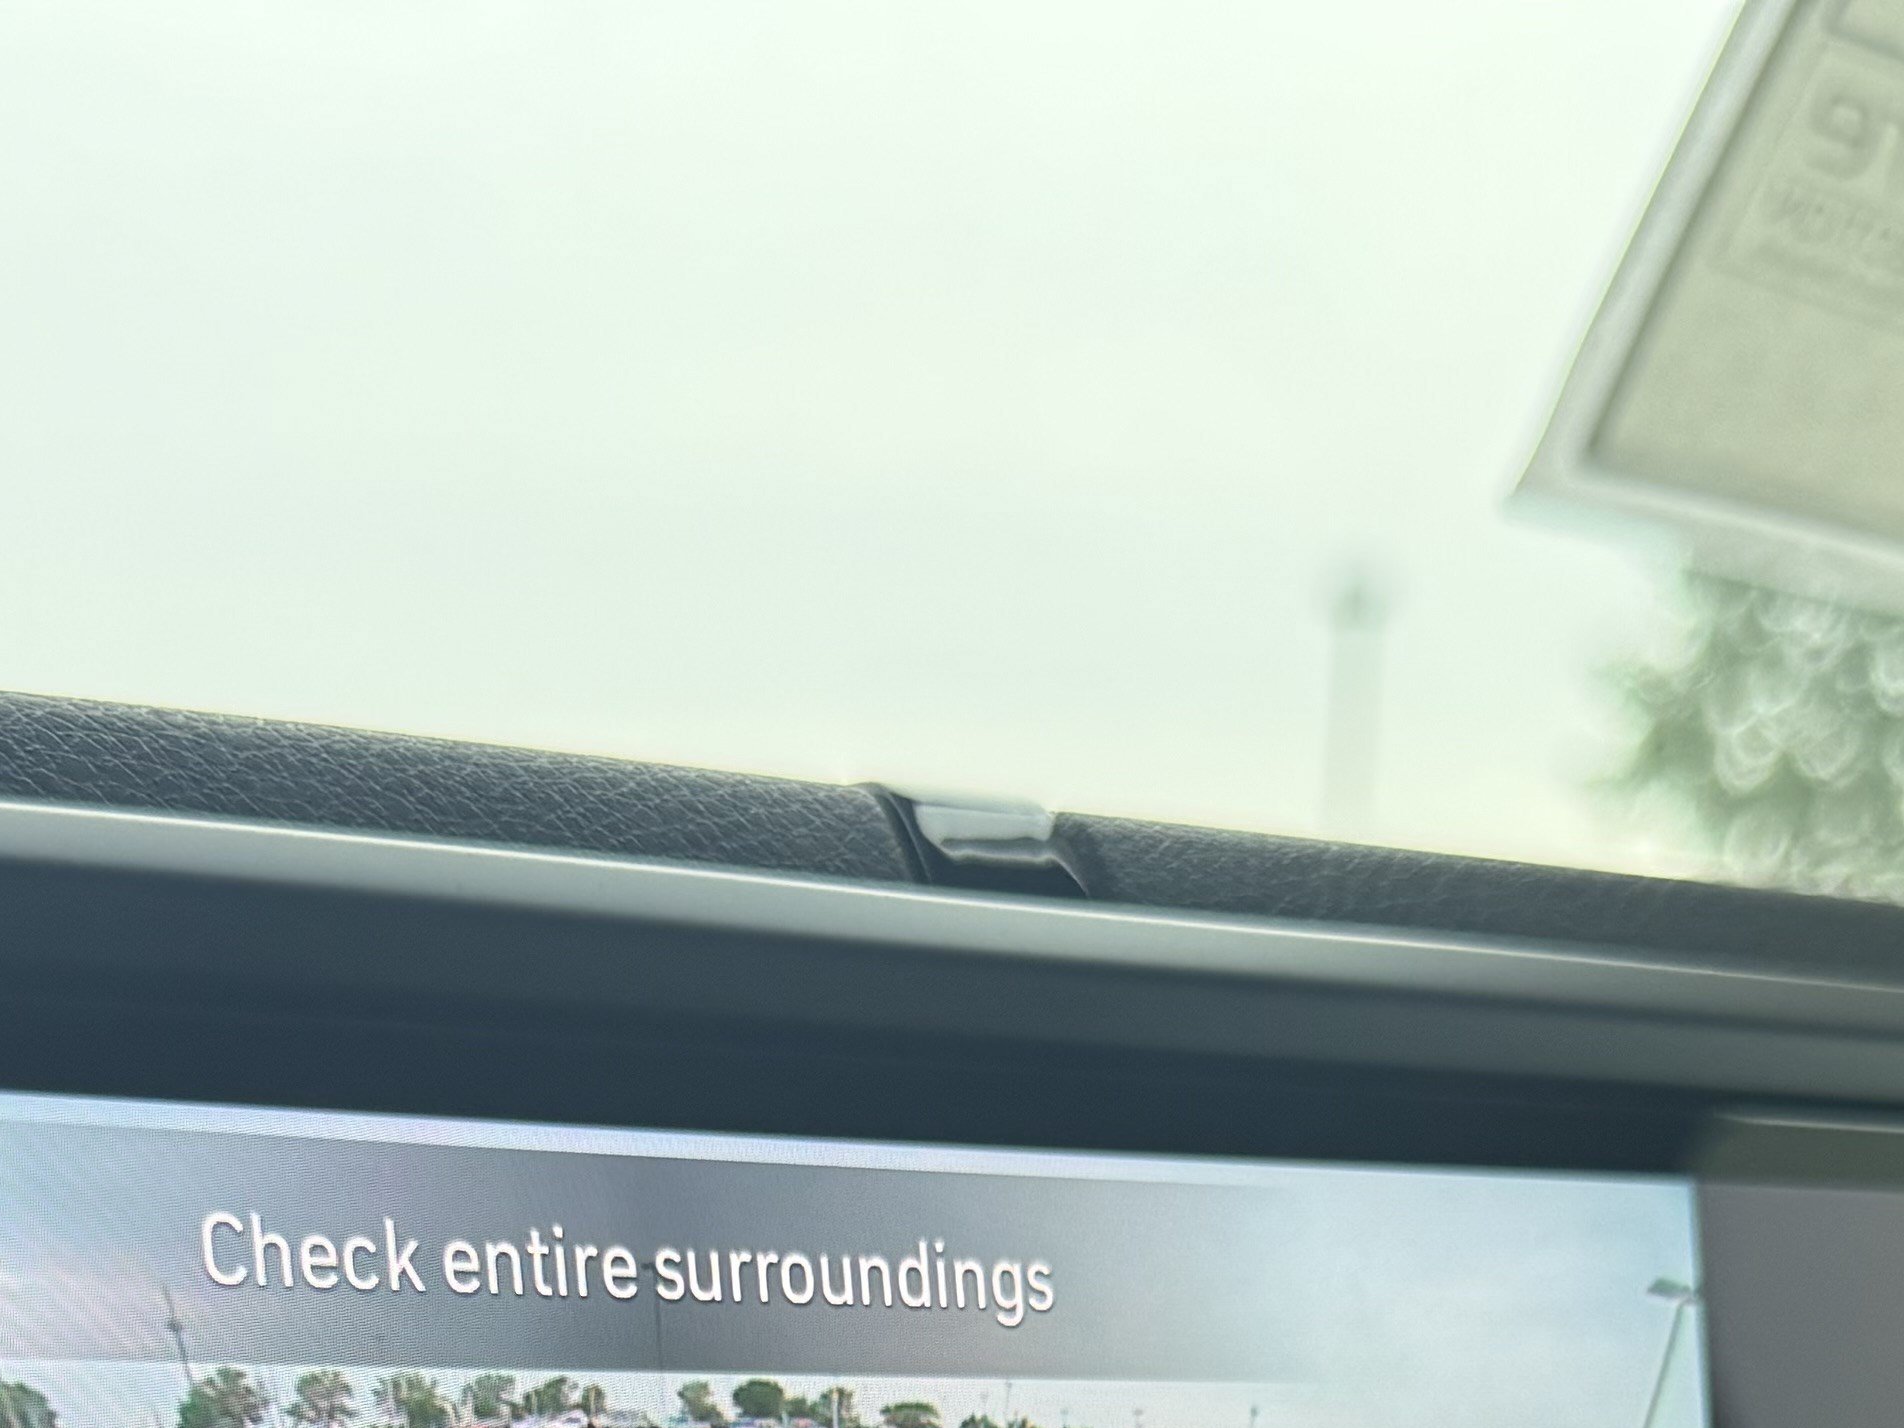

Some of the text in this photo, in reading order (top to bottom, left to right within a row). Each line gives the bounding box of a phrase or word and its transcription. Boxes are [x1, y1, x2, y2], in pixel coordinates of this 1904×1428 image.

[200, 1210, 1056, 1328] Check entire surroundings
